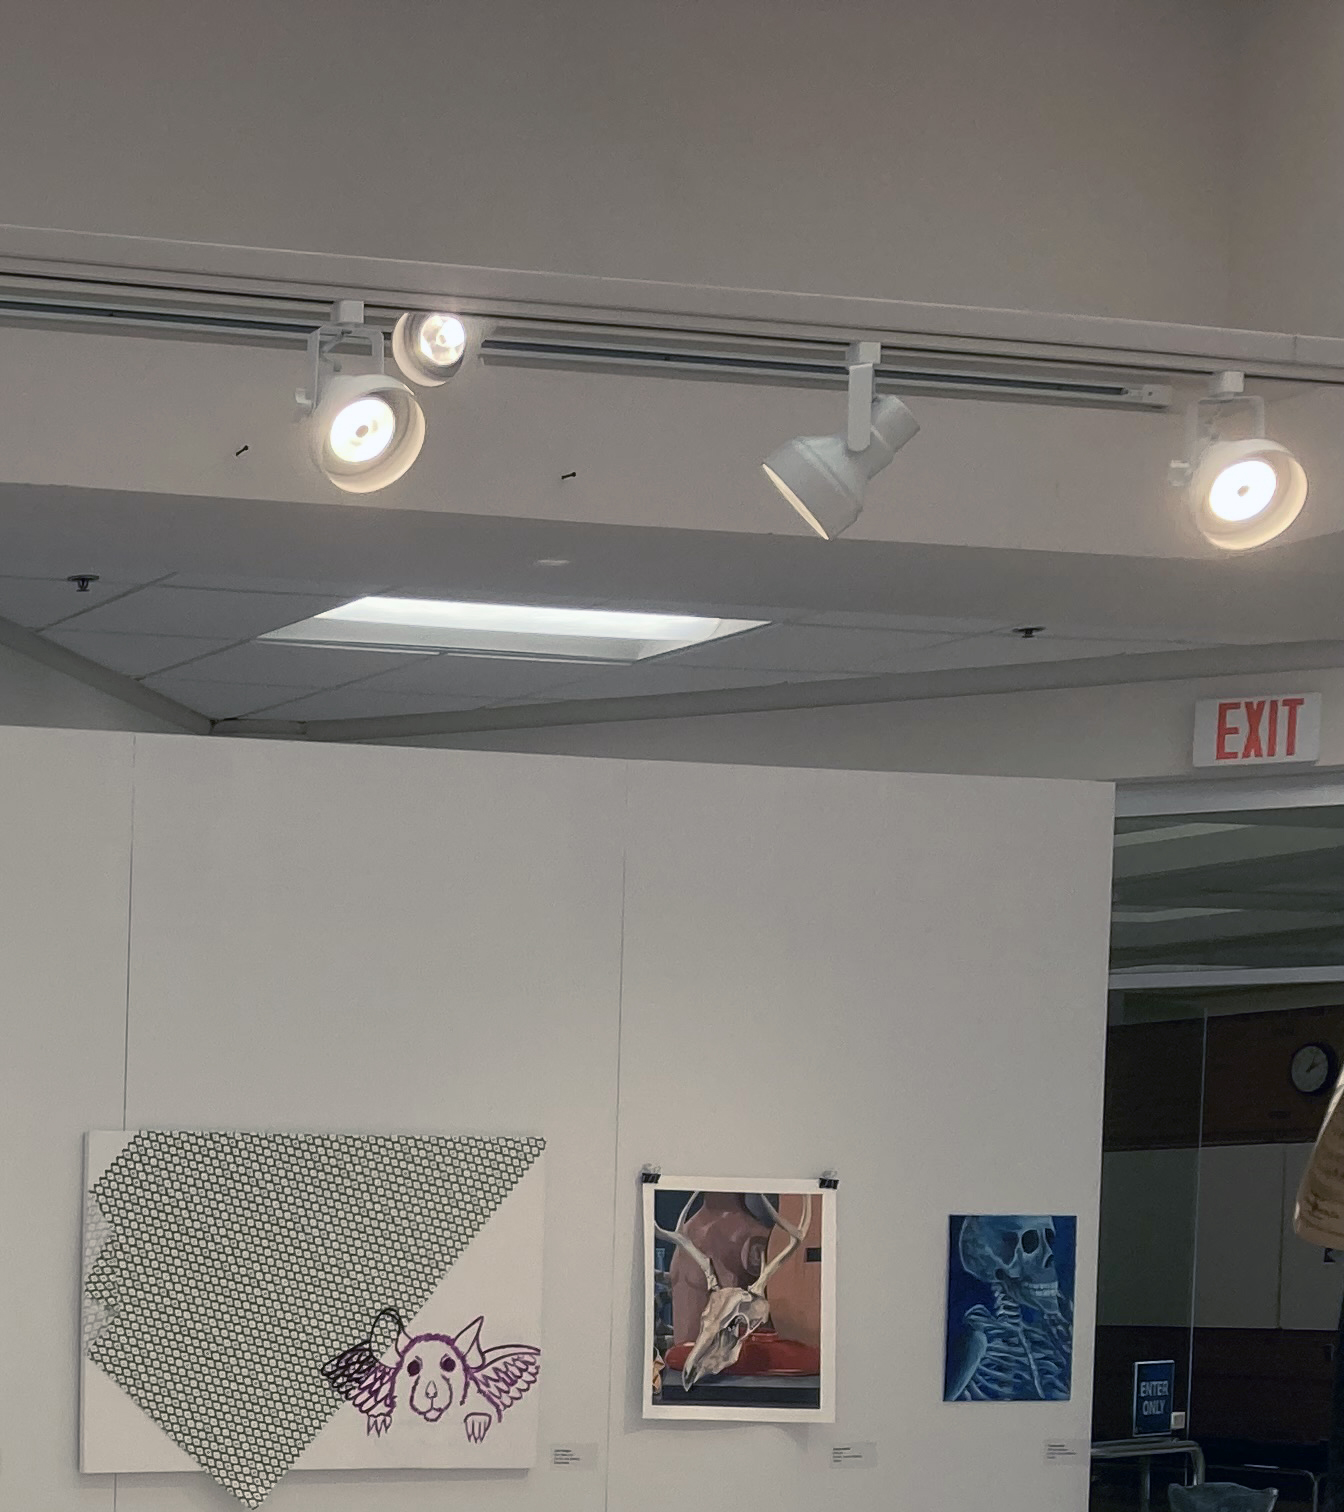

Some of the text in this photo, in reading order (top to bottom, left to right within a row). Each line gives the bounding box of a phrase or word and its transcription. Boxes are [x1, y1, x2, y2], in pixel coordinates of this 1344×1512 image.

[1216, 698, 1304, 760] EXIT
[1140, 1381, 1169, 1397] ENTER
[1142, 1400, 1166, 1416] ONLY
